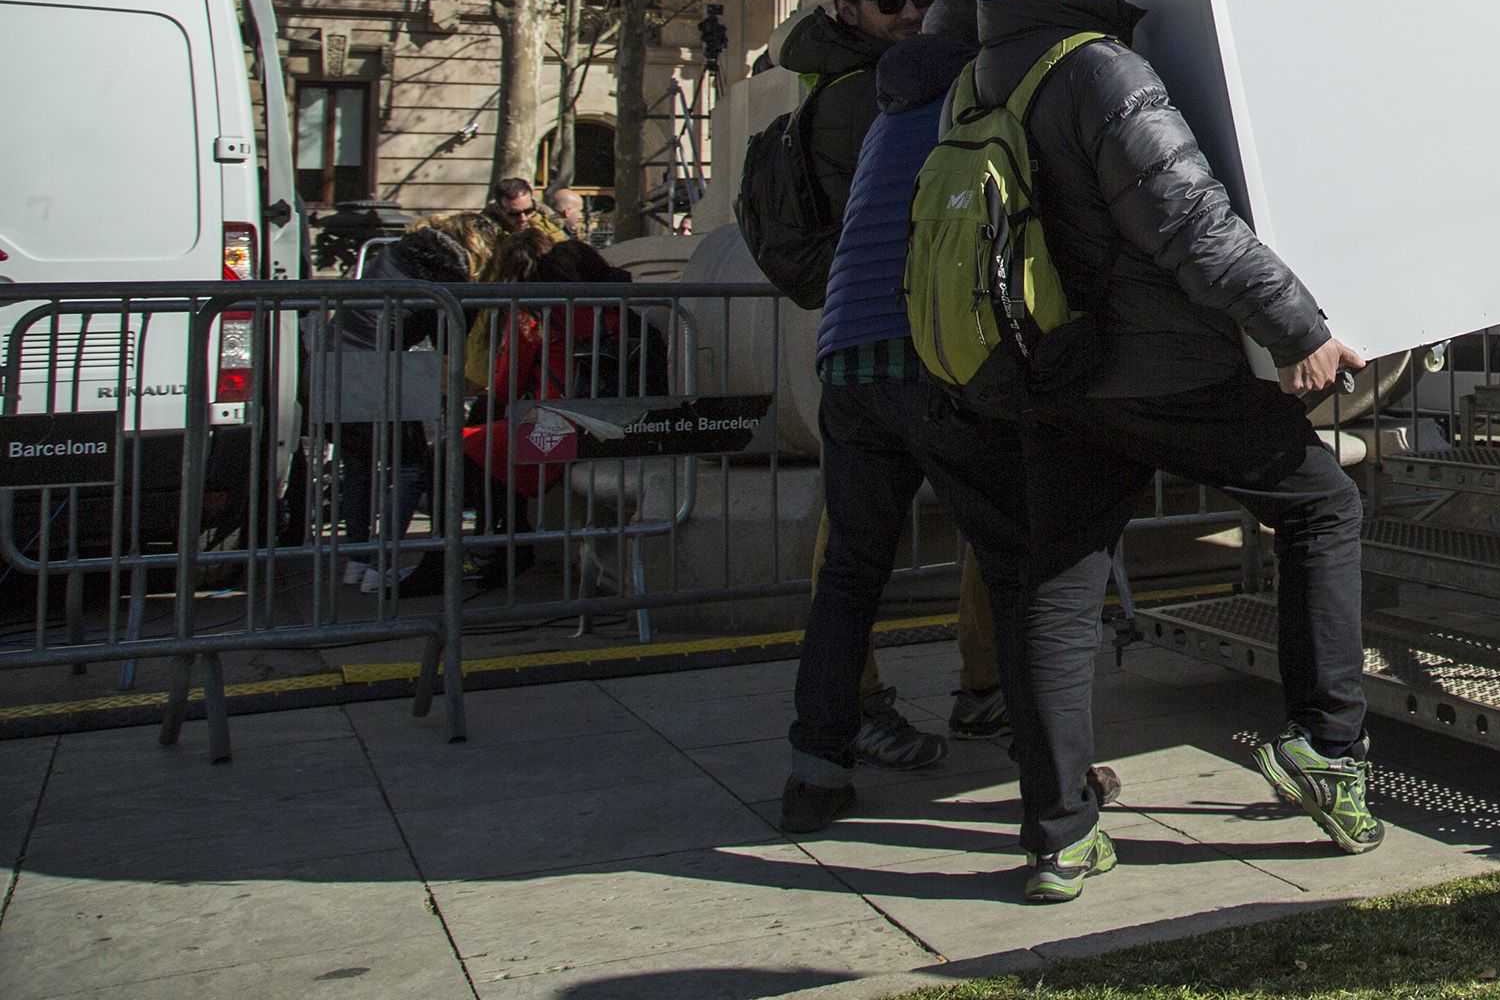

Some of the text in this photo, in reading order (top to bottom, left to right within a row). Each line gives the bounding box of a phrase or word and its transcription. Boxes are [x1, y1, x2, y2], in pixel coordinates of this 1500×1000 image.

[675, 417, 693, 432] de
[698, 416, 759, 431] Barcelon
[9, 440, 108, 457] Barcelona
